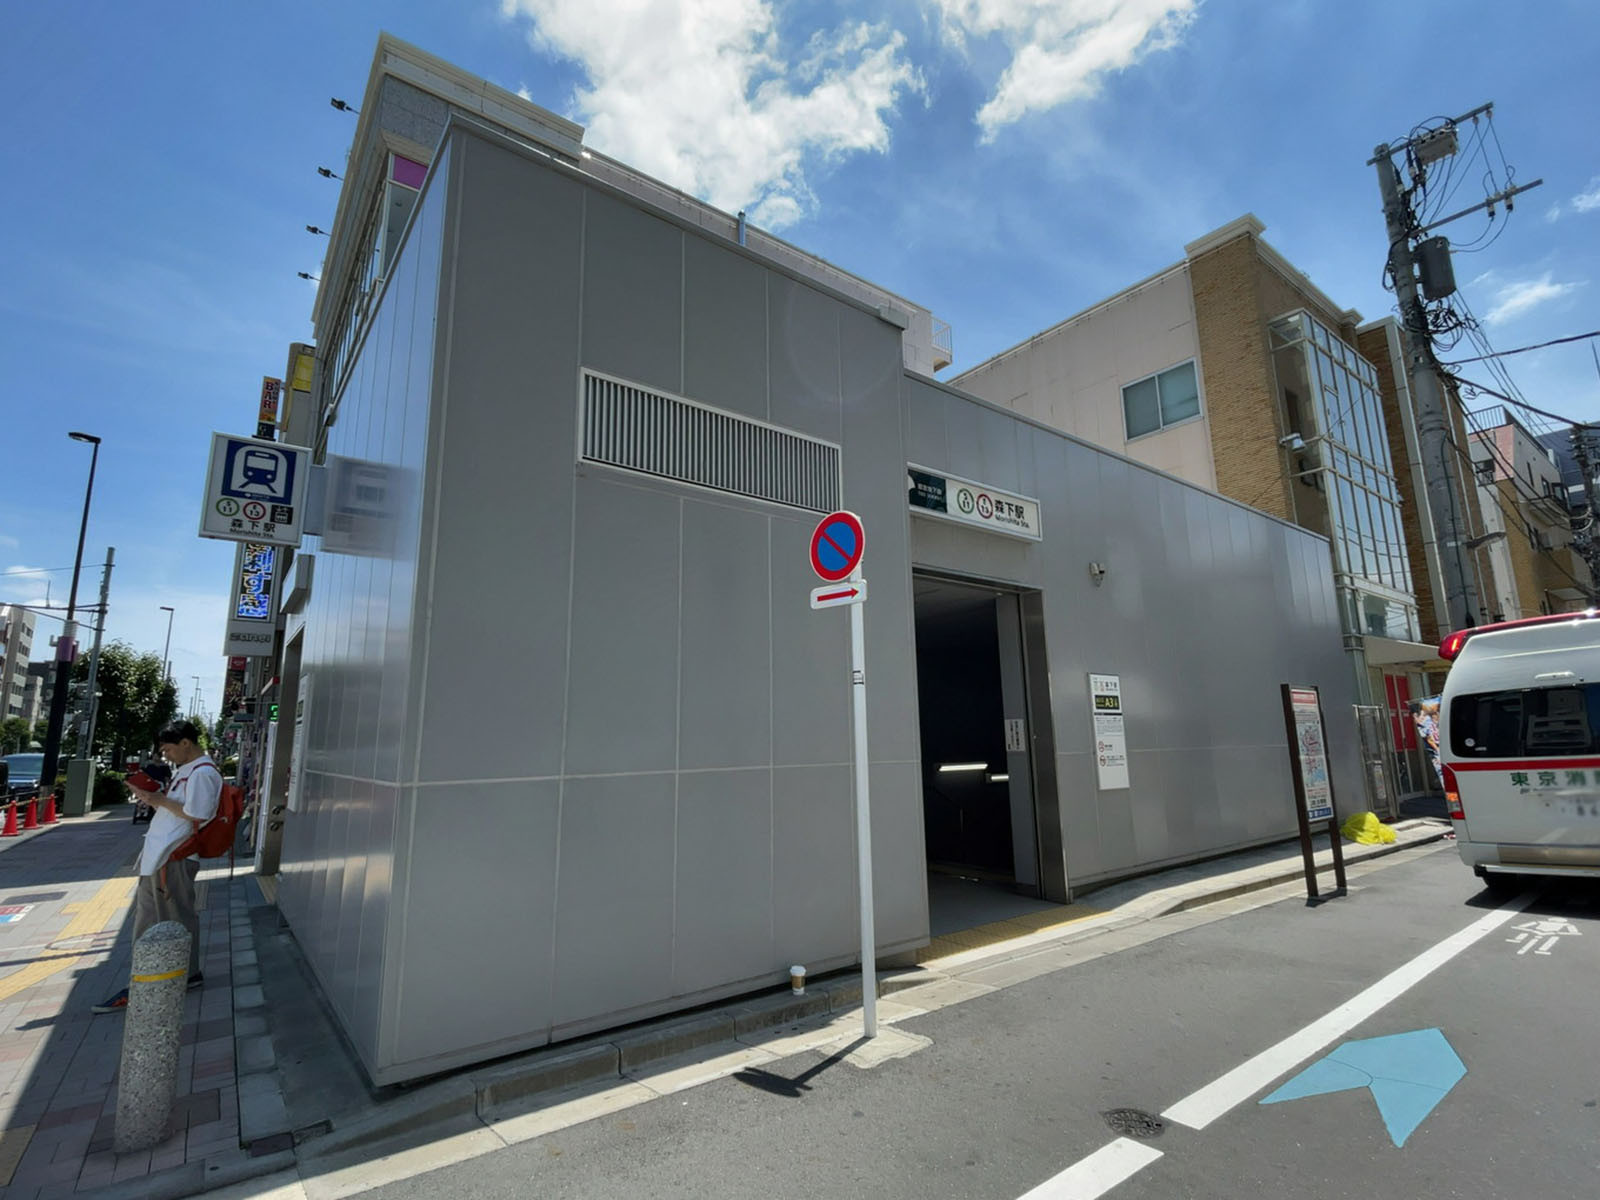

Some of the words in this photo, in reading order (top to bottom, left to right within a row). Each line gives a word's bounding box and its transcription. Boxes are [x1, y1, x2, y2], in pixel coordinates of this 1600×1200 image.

[263, 381, 274, 409] BAR
[994, 499, 1025, 520] 森下駅
[231, 519, 276, 533] 森下駅
[1105, 697, 1114, 708] A3
